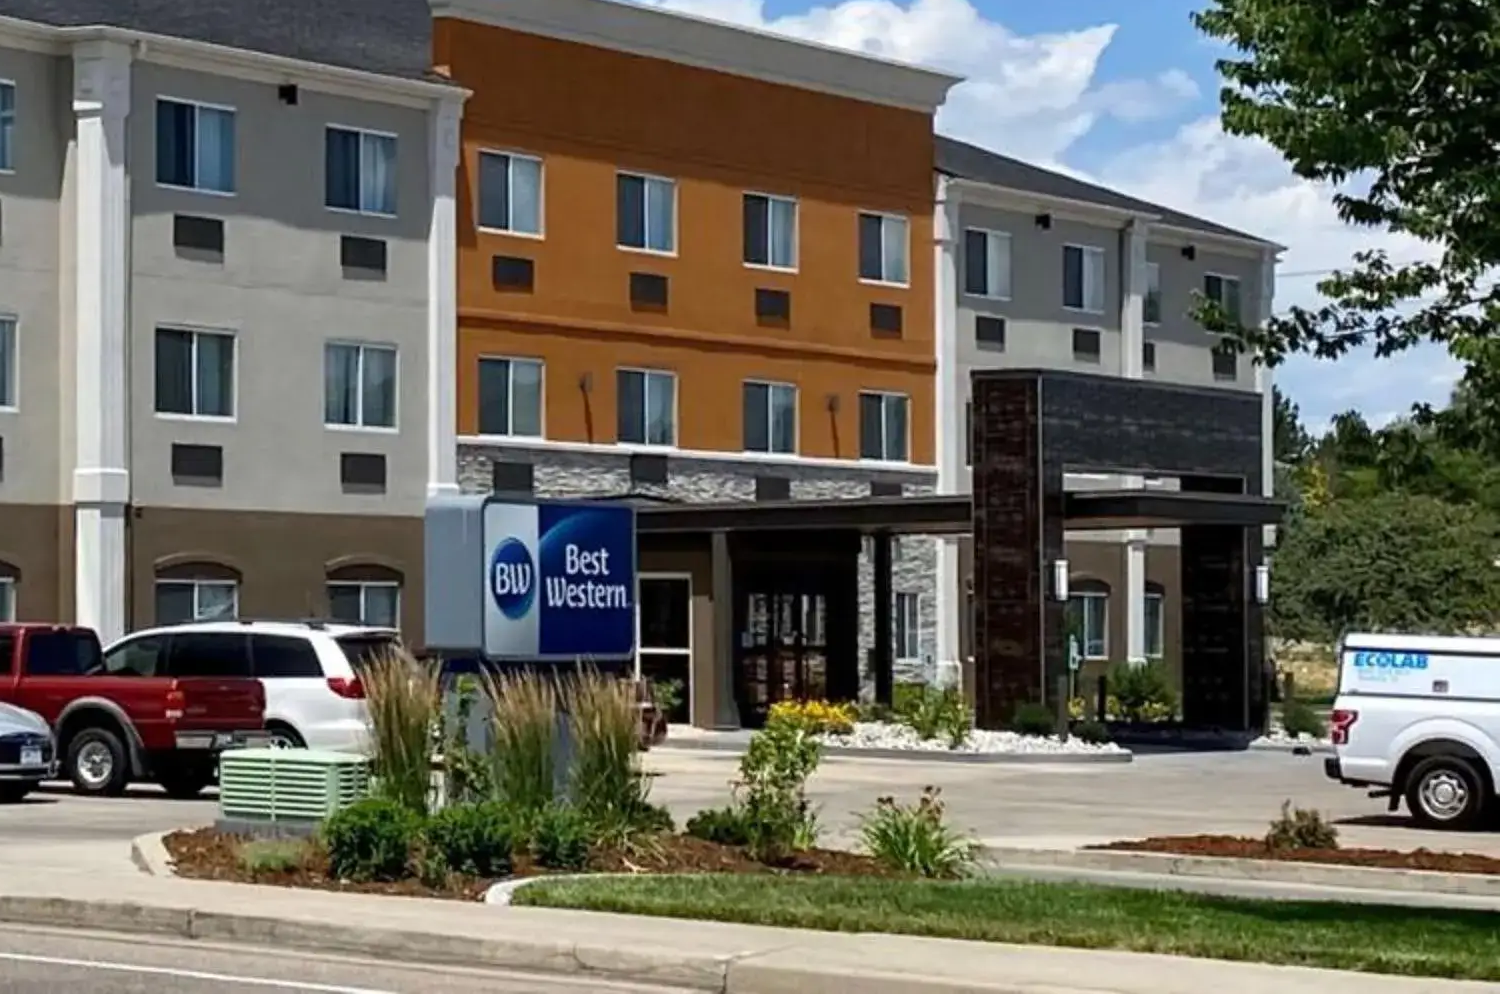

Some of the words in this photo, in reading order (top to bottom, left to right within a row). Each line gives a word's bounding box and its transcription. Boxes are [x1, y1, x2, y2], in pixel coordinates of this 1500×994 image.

[565, 543, 610, 575] Best
[495, 562, 531, 595] BW
[545, 576, 627, 608] Western
[1354, 652, 1428, 669] ECOLAB
